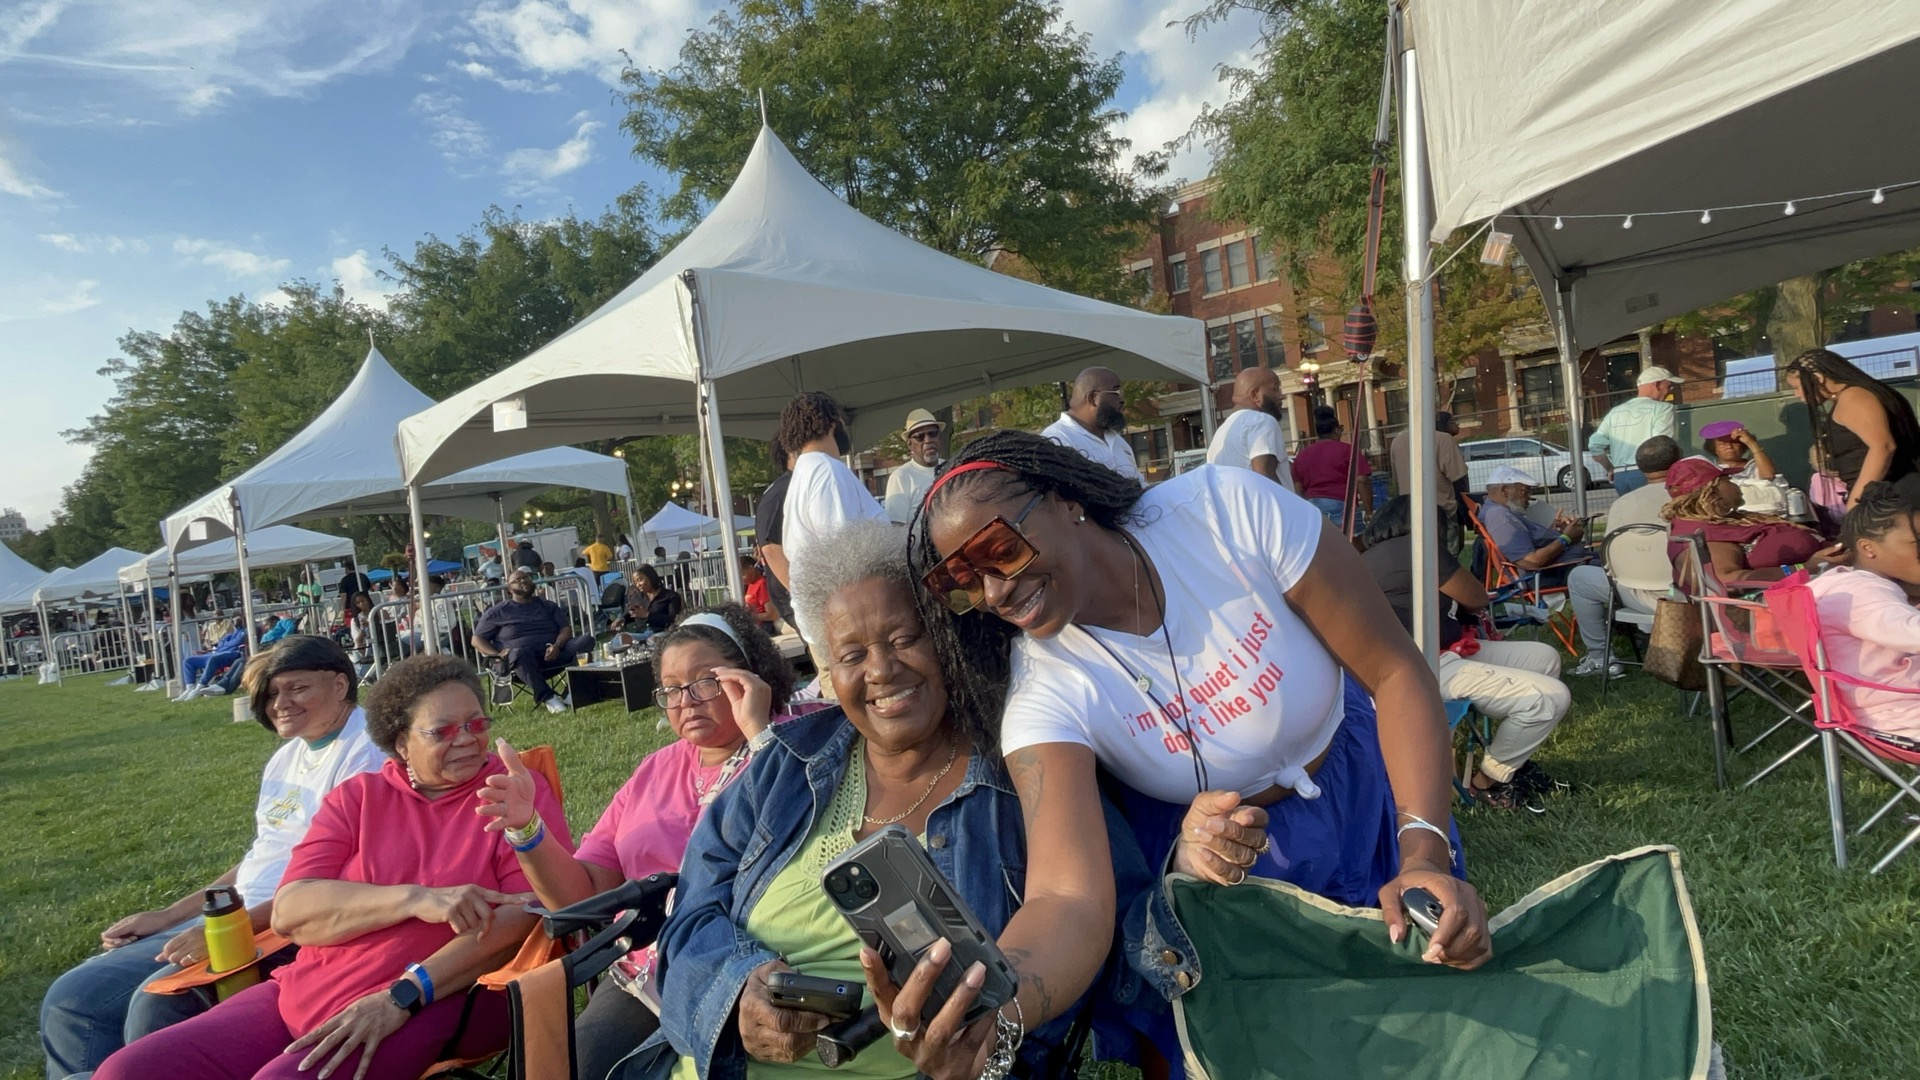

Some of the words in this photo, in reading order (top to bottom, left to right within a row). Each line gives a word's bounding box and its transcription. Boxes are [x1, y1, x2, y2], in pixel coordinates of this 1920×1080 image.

[1228, 648, 1248, 669] i
[1236, 611, 1273, 664] just
[1188, 661, 1239, 706] quiet
[1208, 695, 1252, 727] like
[1248, 661, 1284, 706] you
[1123, 711, 1158, 737] i'm
